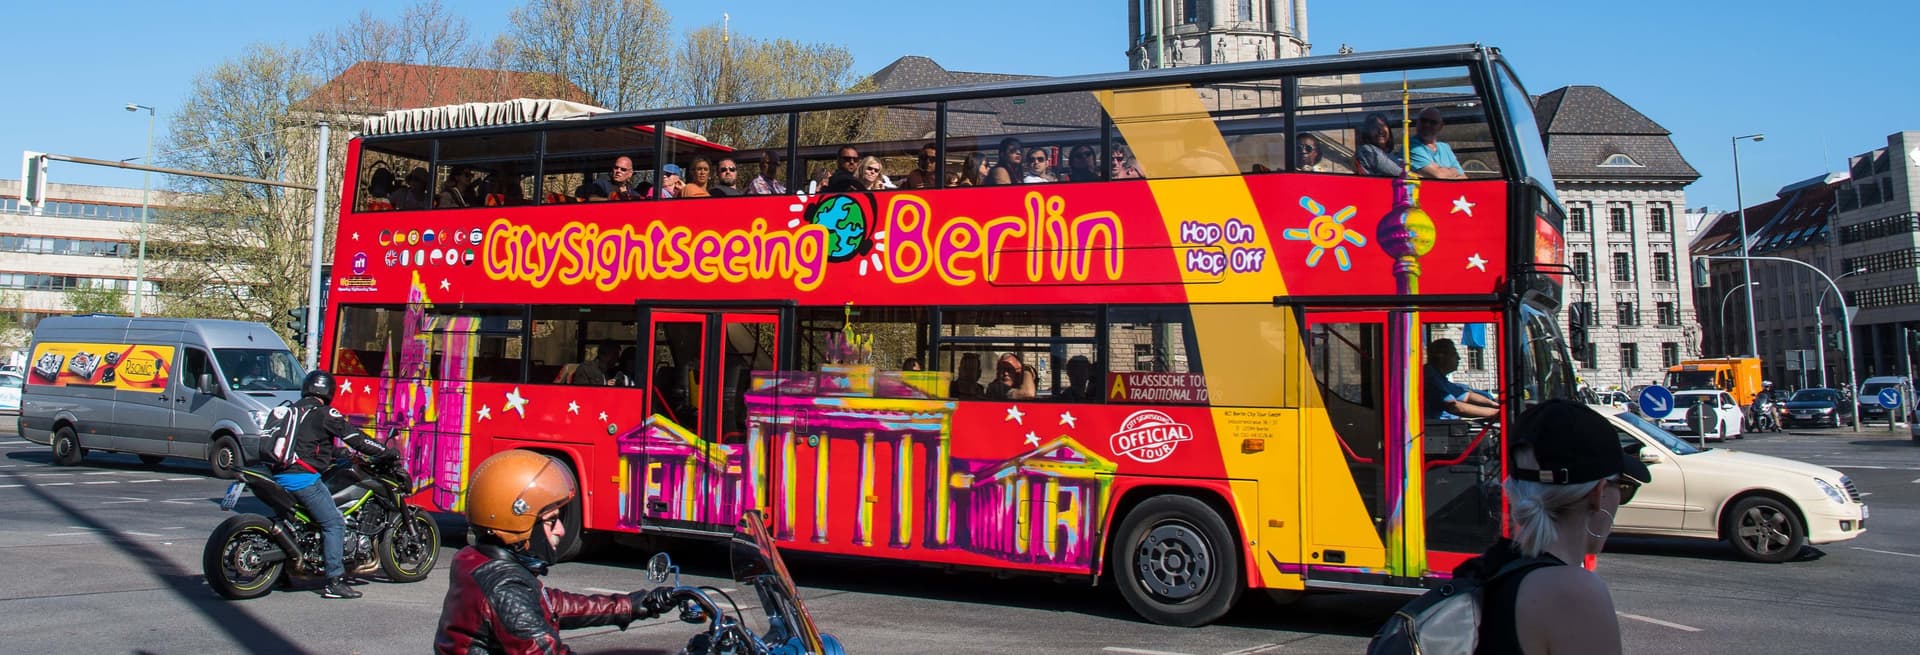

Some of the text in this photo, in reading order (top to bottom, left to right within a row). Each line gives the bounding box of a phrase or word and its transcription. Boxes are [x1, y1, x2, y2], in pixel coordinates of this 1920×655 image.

[884, 191, 1124, 286] Berlin
[1181, 218, 1254, 246] Hop On
[1187, 247, 1265, 275] Hop Off
[1129, 375, 1185, 387] KLASSISCHE
[1130, 388, 1191, 401] TRADITIONAL
[1118, 426, 1188, 450] OFFICIAL
[1140, 443, 1171, 458] TOUR
